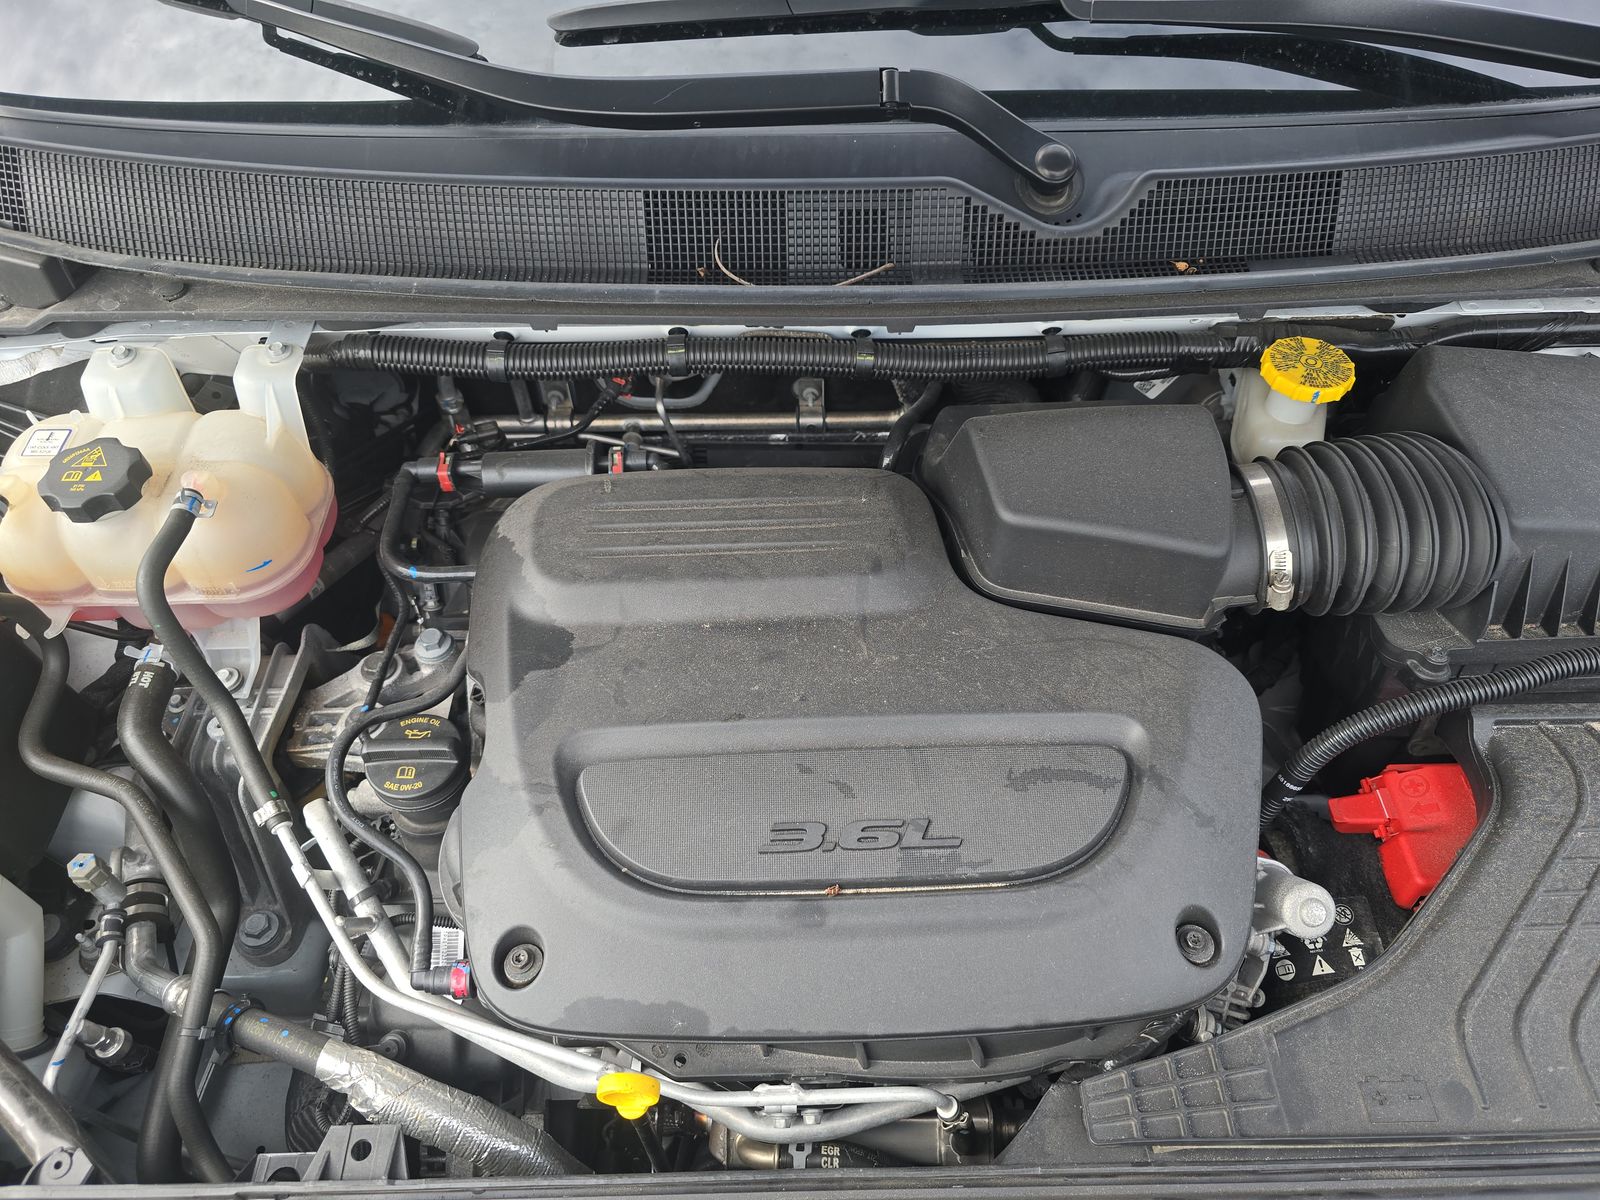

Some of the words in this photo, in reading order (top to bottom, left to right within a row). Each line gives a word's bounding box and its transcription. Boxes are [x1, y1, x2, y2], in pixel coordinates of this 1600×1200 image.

[138, 671, 154, 688] HOT
[400, 717, 428, 727] ENGINE
[429, 717, 441, 727] OIL
[384, 781, 399, 791] SAE
[399, 781, 423, 791] 0W-20
[758, 817, 963, 854] 3.6L
[821, 1145, 840, 1156] EGR
[821, 1156, 840, 1169] CLR
